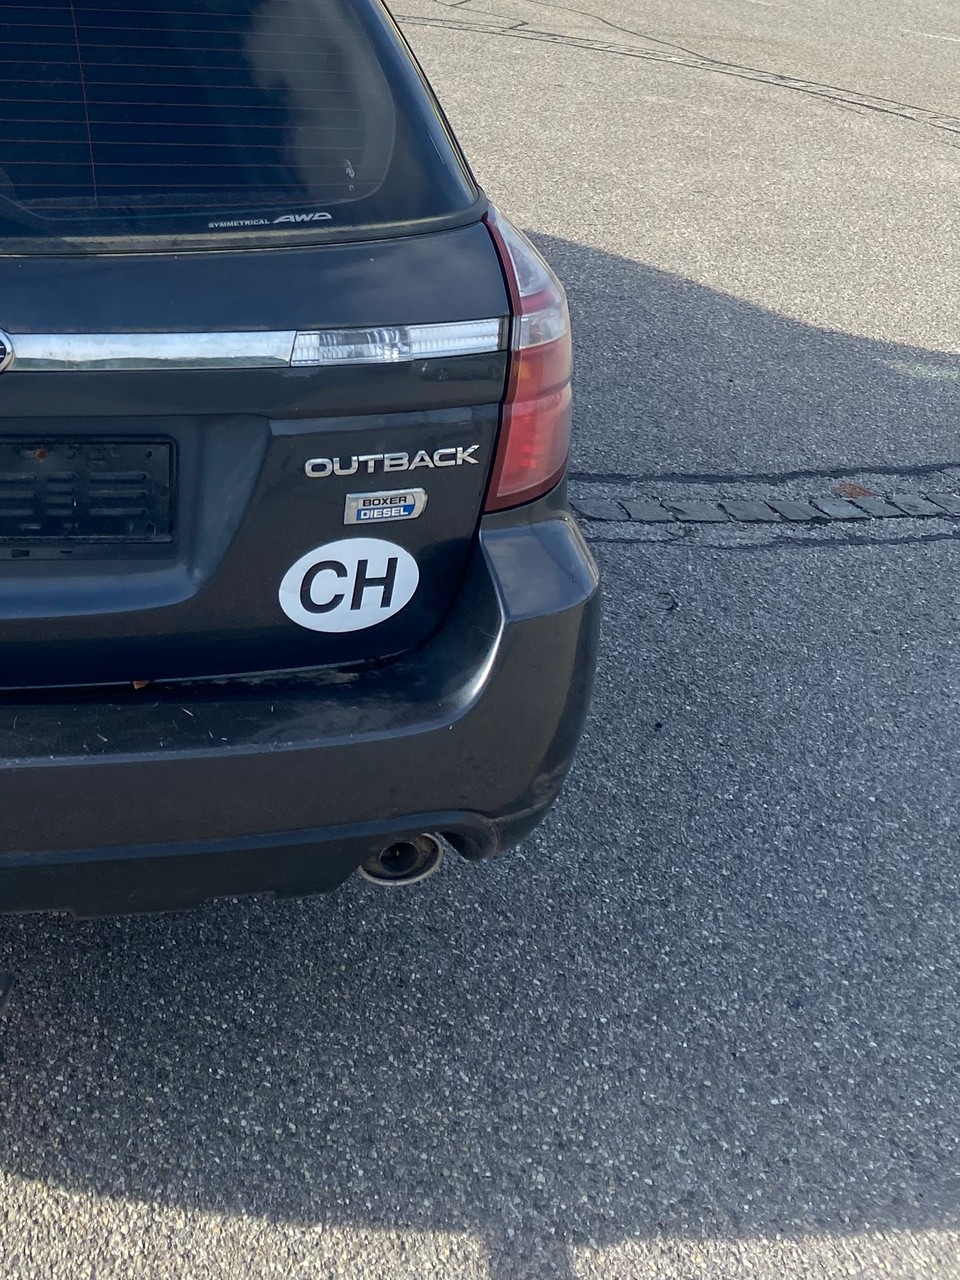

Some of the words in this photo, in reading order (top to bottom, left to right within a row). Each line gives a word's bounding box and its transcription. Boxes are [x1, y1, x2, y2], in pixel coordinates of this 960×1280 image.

[208, 218, 271, 228] SYMMETRICAL
[272, 212, 333, 224] AWD
[304, 444, 481, 478] OUTBACK
[362, 496, 408, 508] BOXER
[360, 506, 409, 520] DIESEL
[299, 556, 399, 615] CH
